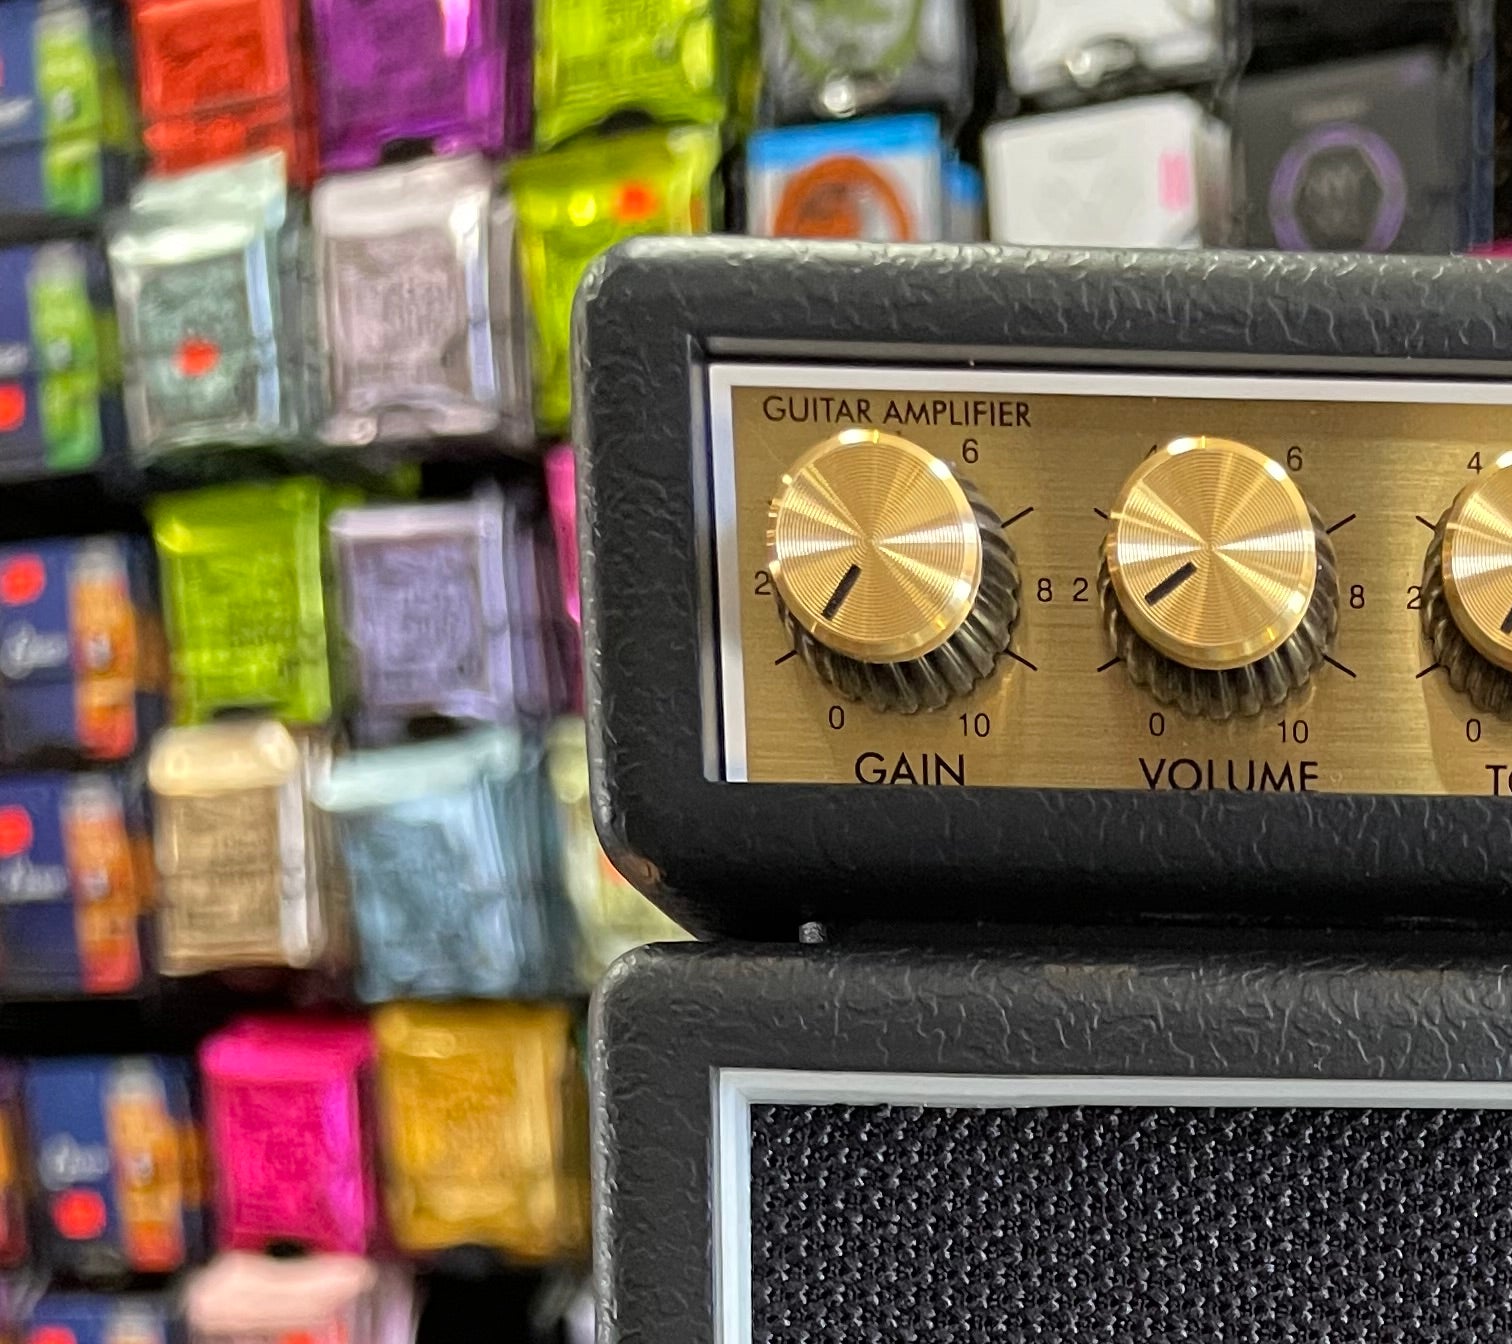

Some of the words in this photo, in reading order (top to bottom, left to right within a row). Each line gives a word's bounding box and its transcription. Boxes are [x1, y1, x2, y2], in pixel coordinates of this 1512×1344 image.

[762, 395, 872, 423] GUITAR
[883, 399, 1032, 427] AMPLIFIER
[962, 438, 979, 464] 6
[1286, 446, 1303, 471] 6
[1466, 451, 1484, 475] 4
[754, 570, 771, 595] 2
[1037, 578, 1053, 602] 8
[1072, 577, 1089, 602] 2
[1350, 585, 1365, 609] 8
[1407, 585, 1422, 610] 2
[829, 705, 845, 730] 0
[960, 712, 990, 738] 10
[1150, 712, 1165, 737] 0
[1277, 719, 1309, 744] 10
[1466, 718, 1481, 743] 0
[854, 751, 965, 786] GAIN
[1138, 758, 1319, 792] VOLUME
